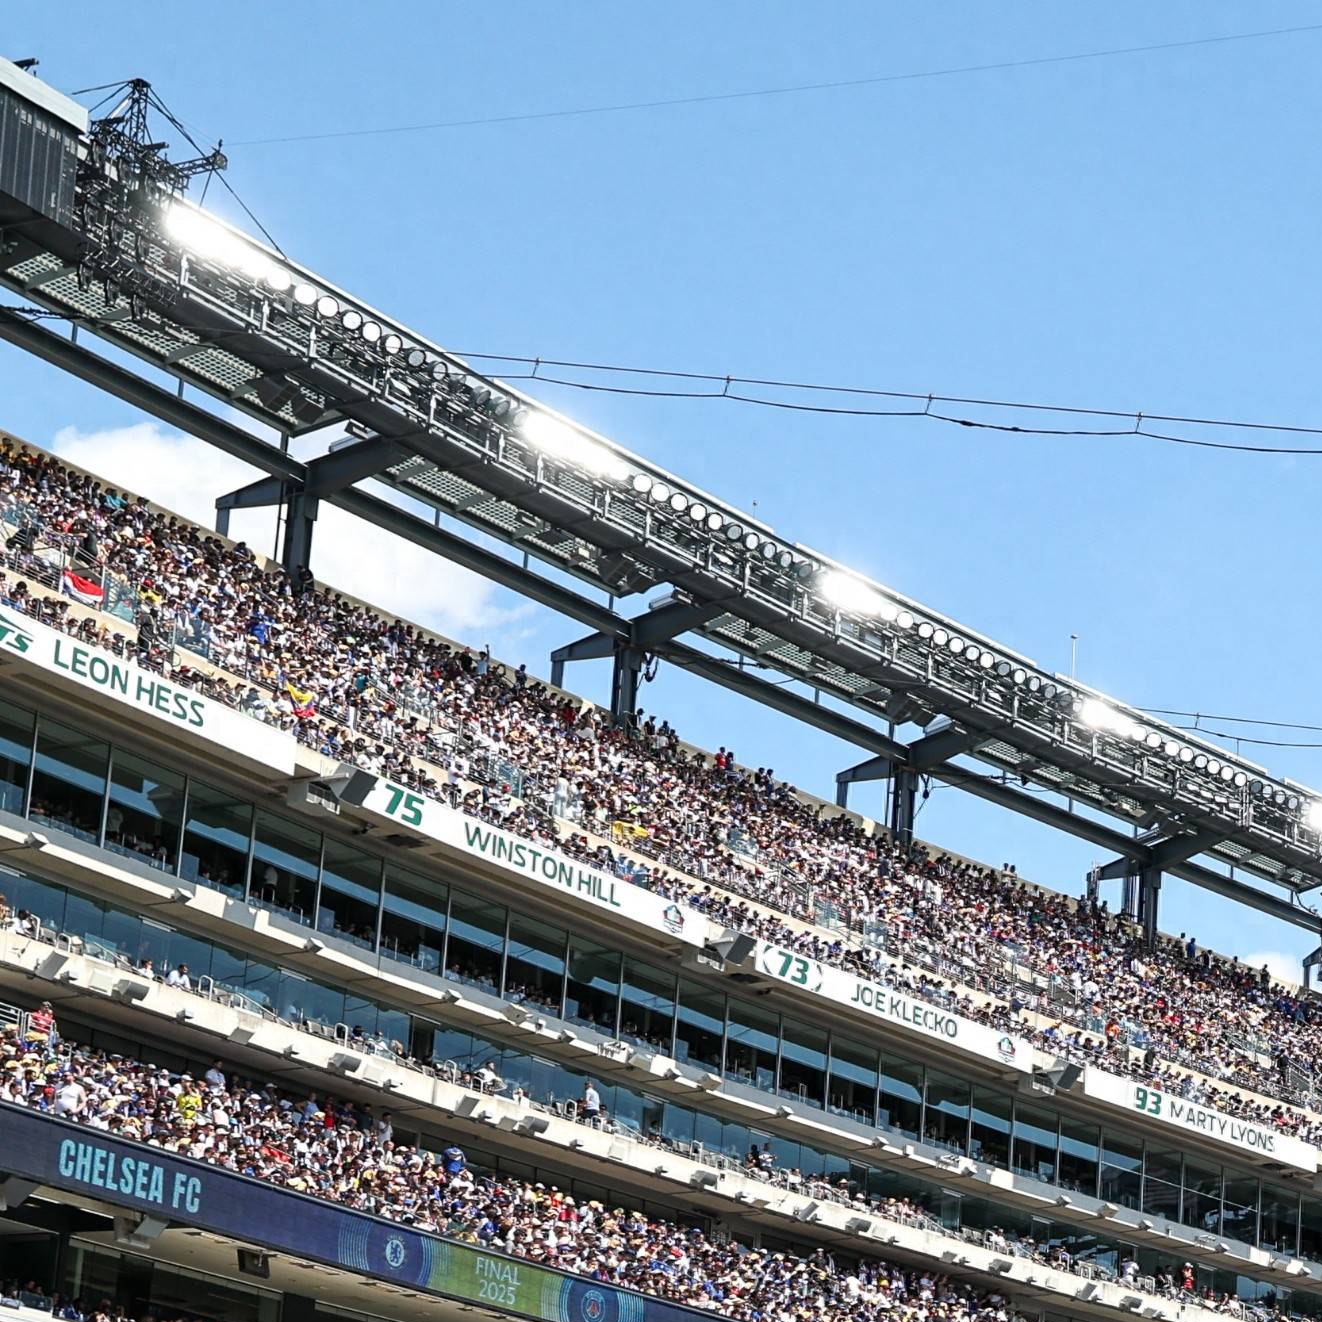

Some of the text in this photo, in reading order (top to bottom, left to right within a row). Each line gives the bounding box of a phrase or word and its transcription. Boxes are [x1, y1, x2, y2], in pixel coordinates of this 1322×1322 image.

[54, 639, 205, 727] LEON HESS
[384, 783, 425, 826] 75
[464, 821, 621, 907] WINSTON HILL
[776, 950, 809, 985] 73
[851, 983, 958, 1038] JOE KLECKO
[1135, 1086, 1161, 1115] 93
[1170, 1101, 1275, 1152] MARTY LYONS
[58, 1138, 201, 1214] CHELSEA FC
[475, 1256, 521, 1286] FINAL
[479, 1279, 516, 1305] 2025
